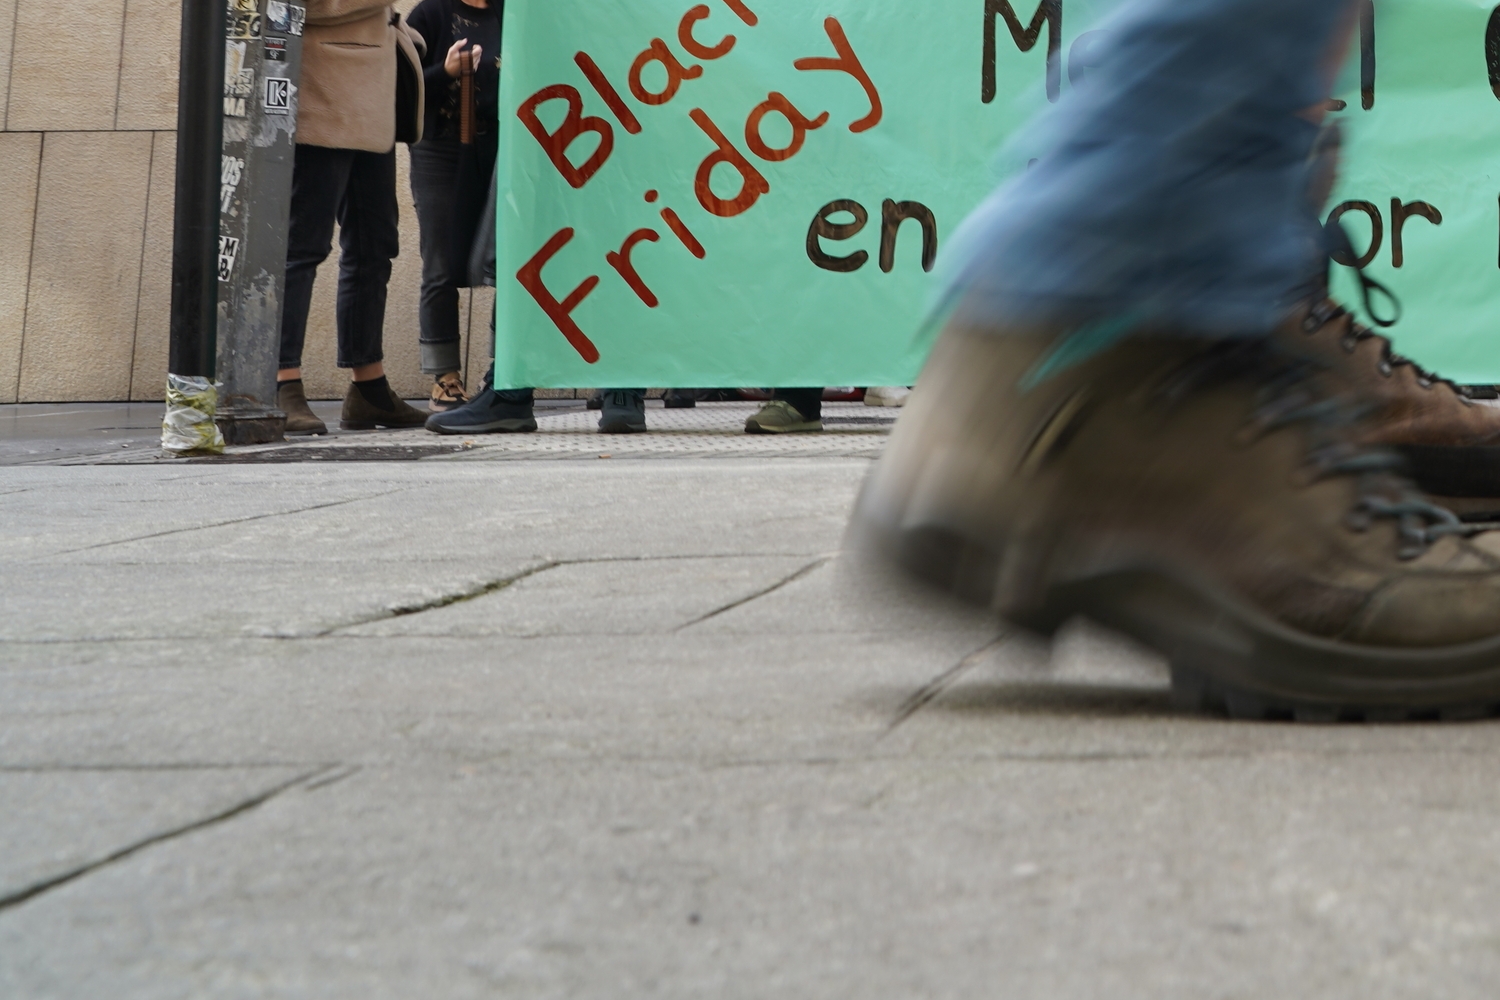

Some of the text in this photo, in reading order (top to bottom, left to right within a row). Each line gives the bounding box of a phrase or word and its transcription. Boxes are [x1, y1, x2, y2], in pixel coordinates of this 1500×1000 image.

[515, 14, 884, 365] Friday
[805, 198, 938, 274] en
[1325, 196, 1443, 270] or
